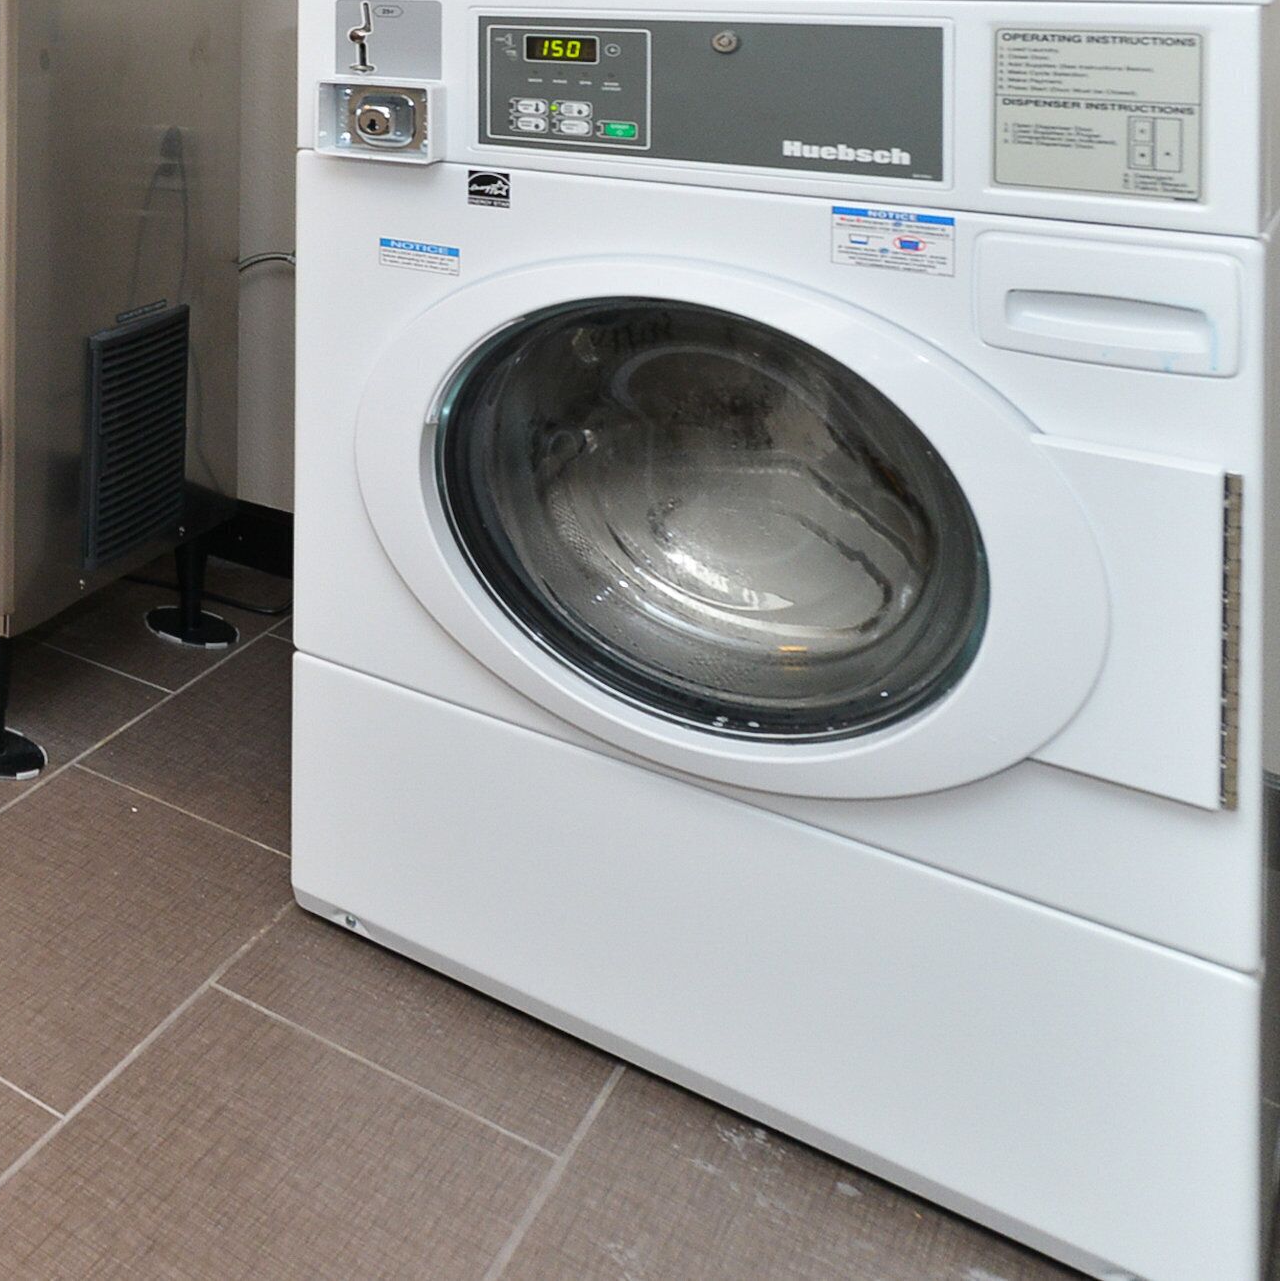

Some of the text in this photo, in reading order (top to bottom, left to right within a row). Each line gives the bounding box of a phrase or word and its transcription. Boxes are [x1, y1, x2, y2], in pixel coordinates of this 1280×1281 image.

[1002, 32, 1197, 47] OPERATING INSTRUCTIONS
[542, 40, 581, 58] 150
[1002, 97, 1195, 116] DISPENSER INSTRUCTIONS
[782, 140, 911, 165] Huebsch
[867, 209, 917, 220] NOTICE
[390, 240, 449, 255] NOTICE
